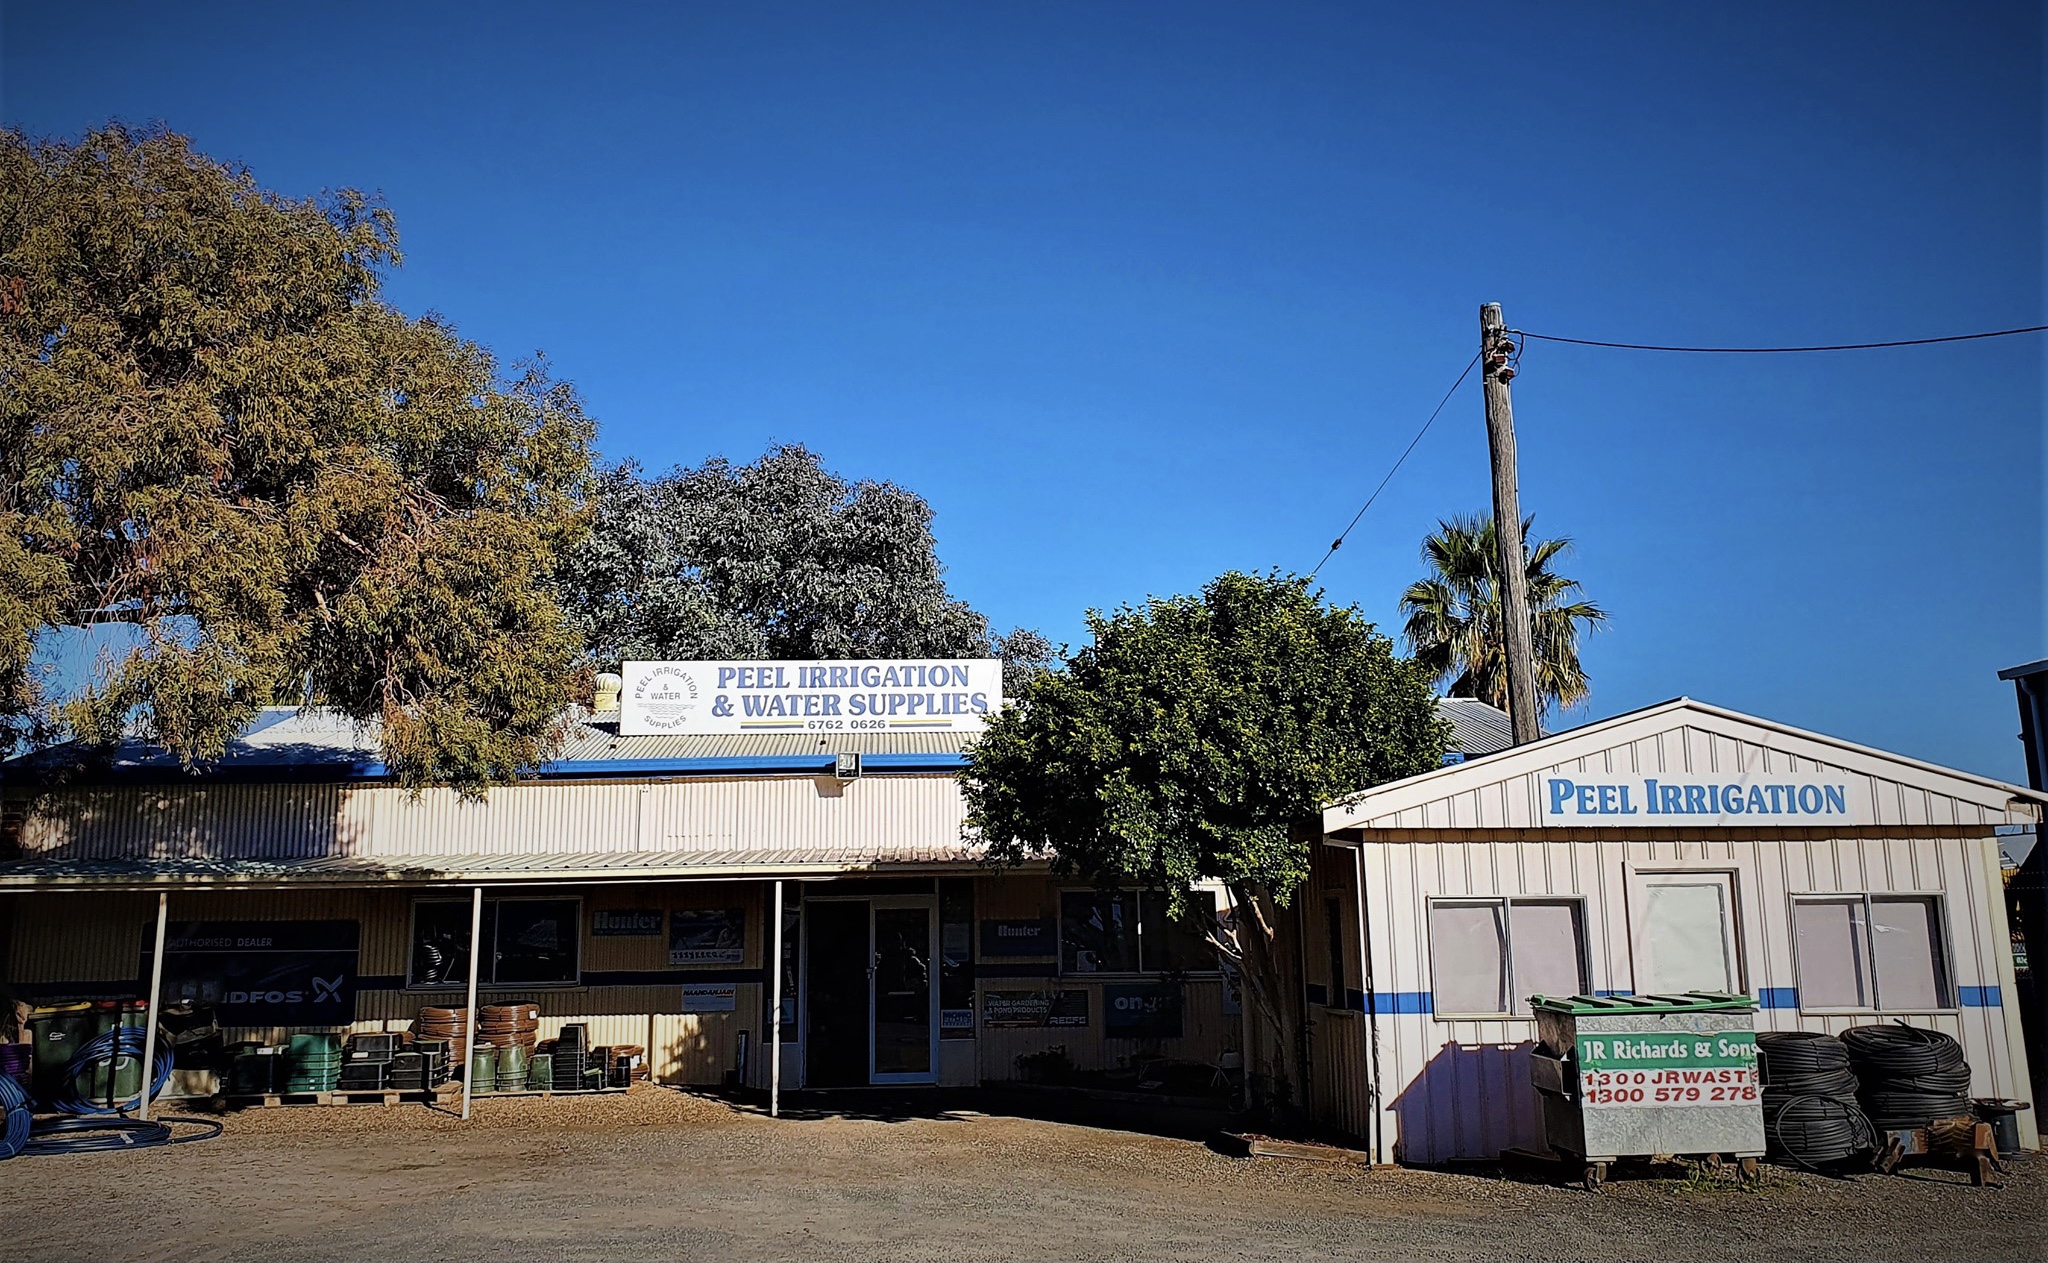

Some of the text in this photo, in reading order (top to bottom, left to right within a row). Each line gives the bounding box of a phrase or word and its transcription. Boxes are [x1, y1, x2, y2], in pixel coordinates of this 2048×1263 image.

[634, 666, 698, 699] PEEL IRRIGATION
[717, 664, 969, 689] PEEL IRRIGATION
[663, 683, 668, 691] &
[650, 692, 680, 700] WATER
[711, 691, 988, 718] & WATER SUPPLIES
[644, 715, 686, 729] SUPPLIES
[807, 719, 886, 730] 6762 0626
[1547, 778, 1846, 815] PEEL IRRIGATION
[593, 911, 661, 929] Hunter
[997, 924, 1042, 937] Hunter
[236, 937, 273, 948] DEALER
[987, 999, 1051, 1007] WATER GARDENING
[994, 1006, 1012, 1014] POND
[1012, 1006, 1048, 1014] PRODUCTS
[1583, 1040, 1607, 1062] JR
[1613, 1039, 1688, 1060] Richards
[1694, 1041, 1713, 1058] &
[1585, 1072, 1646, 1086] 1300
[1586, 1086, 1757, 1104] 1300 579 278
